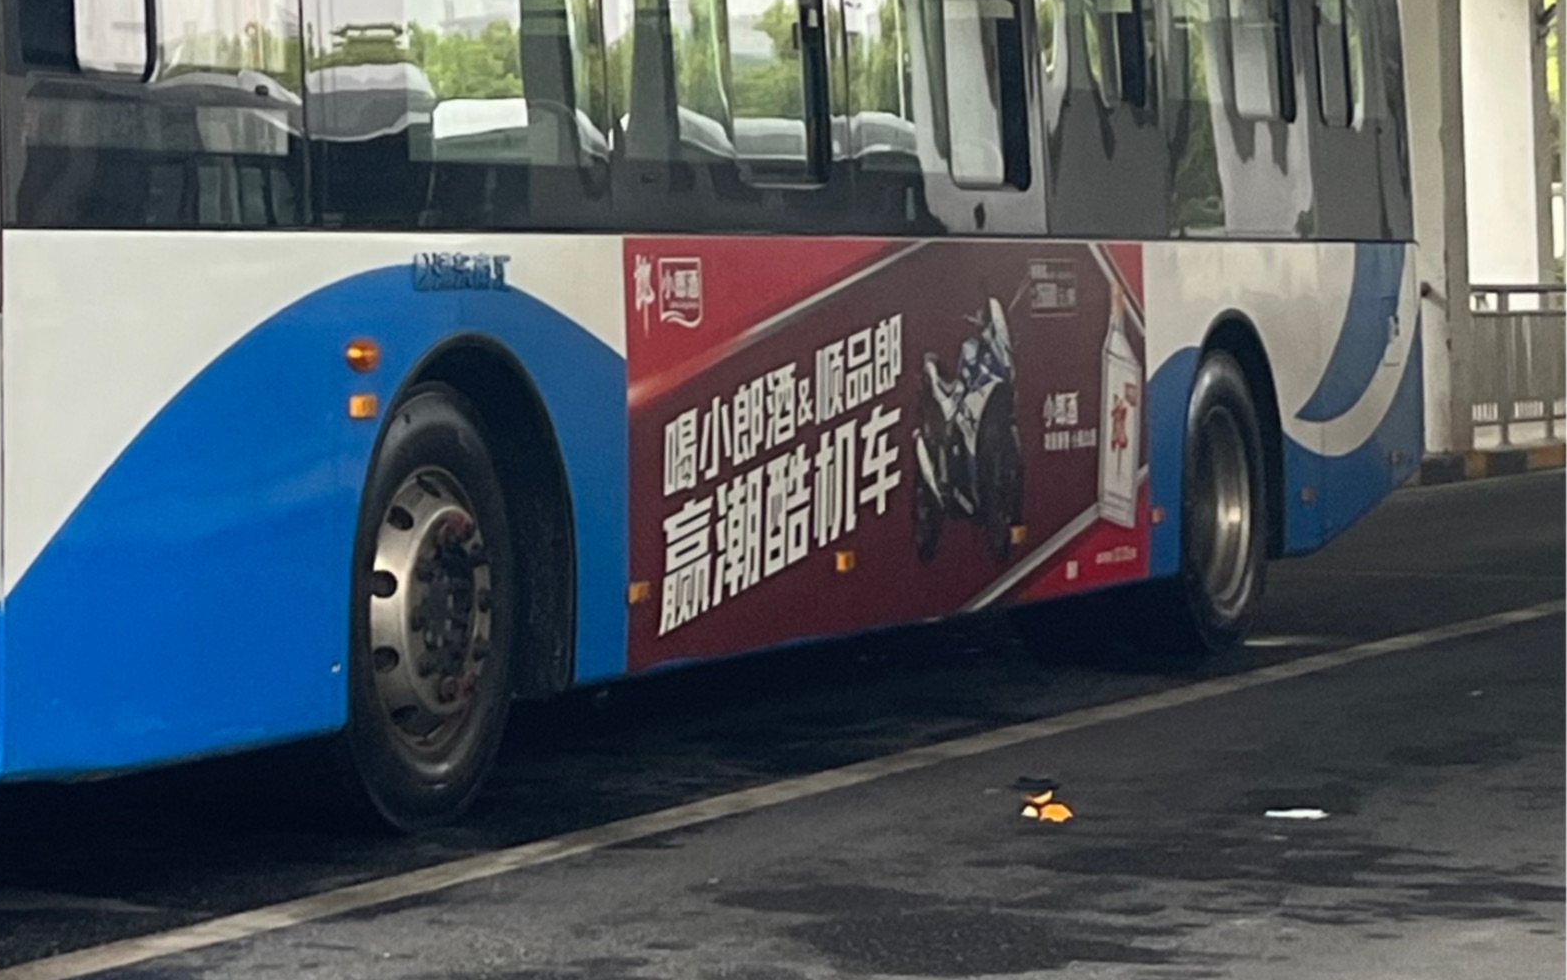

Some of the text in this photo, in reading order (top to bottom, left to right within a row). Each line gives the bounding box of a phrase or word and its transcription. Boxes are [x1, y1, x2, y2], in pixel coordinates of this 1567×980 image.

[663, 313, 903, 498] 喝小郎酒&顺品郎
[657, 404, 902, 637] 赢潮酷机车
